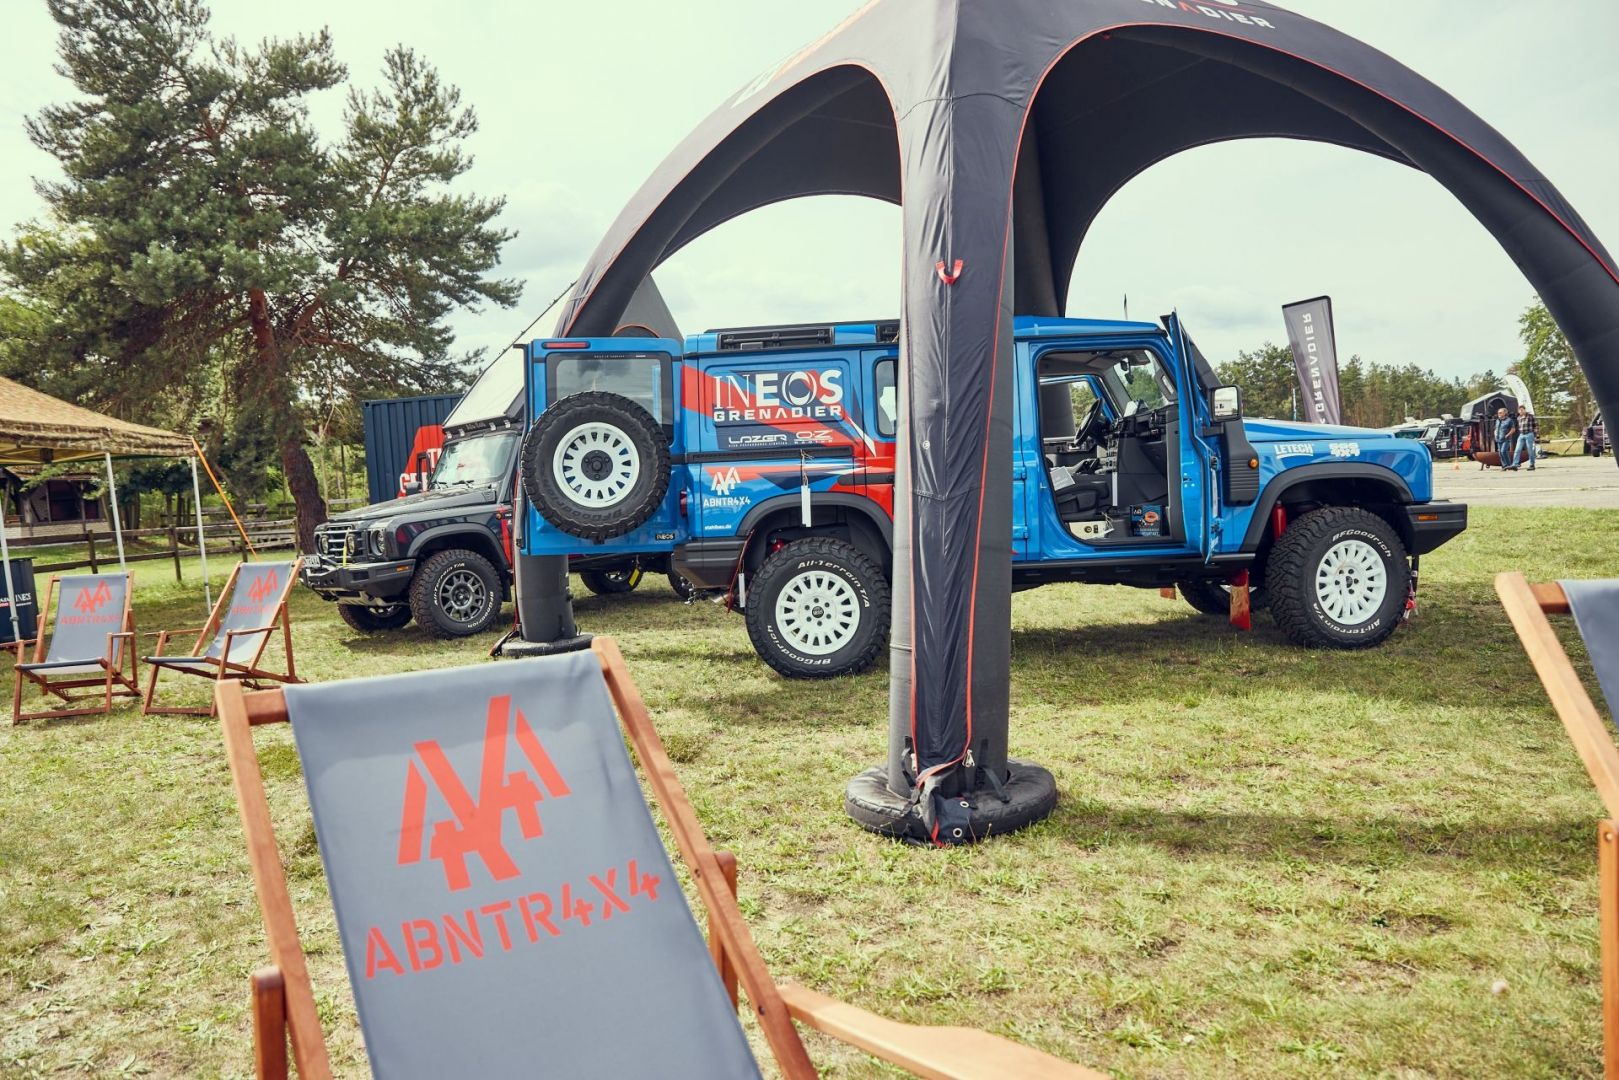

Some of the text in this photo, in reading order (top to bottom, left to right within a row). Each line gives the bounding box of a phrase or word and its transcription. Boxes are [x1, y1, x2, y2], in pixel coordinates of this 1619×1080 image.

[714, 369, 843, 410] INEOS
[713, 405, 842, 422] GRENADIER
[728, 434, 787, 444] LAZER
[1274, 443, 1313, 454] LETECH
[703, 496, 751, 507] ABNTR4X4
[1332, 529, 1392, 557] BFGoodrich
[797, 560, 870, 608] All-Terrain T/A
[1325, 618, 1381, 634] All-Terrain
[767, 625, 831, 665] BFGoodrich
[365, 858, 661, 980] ABNTR4X4
